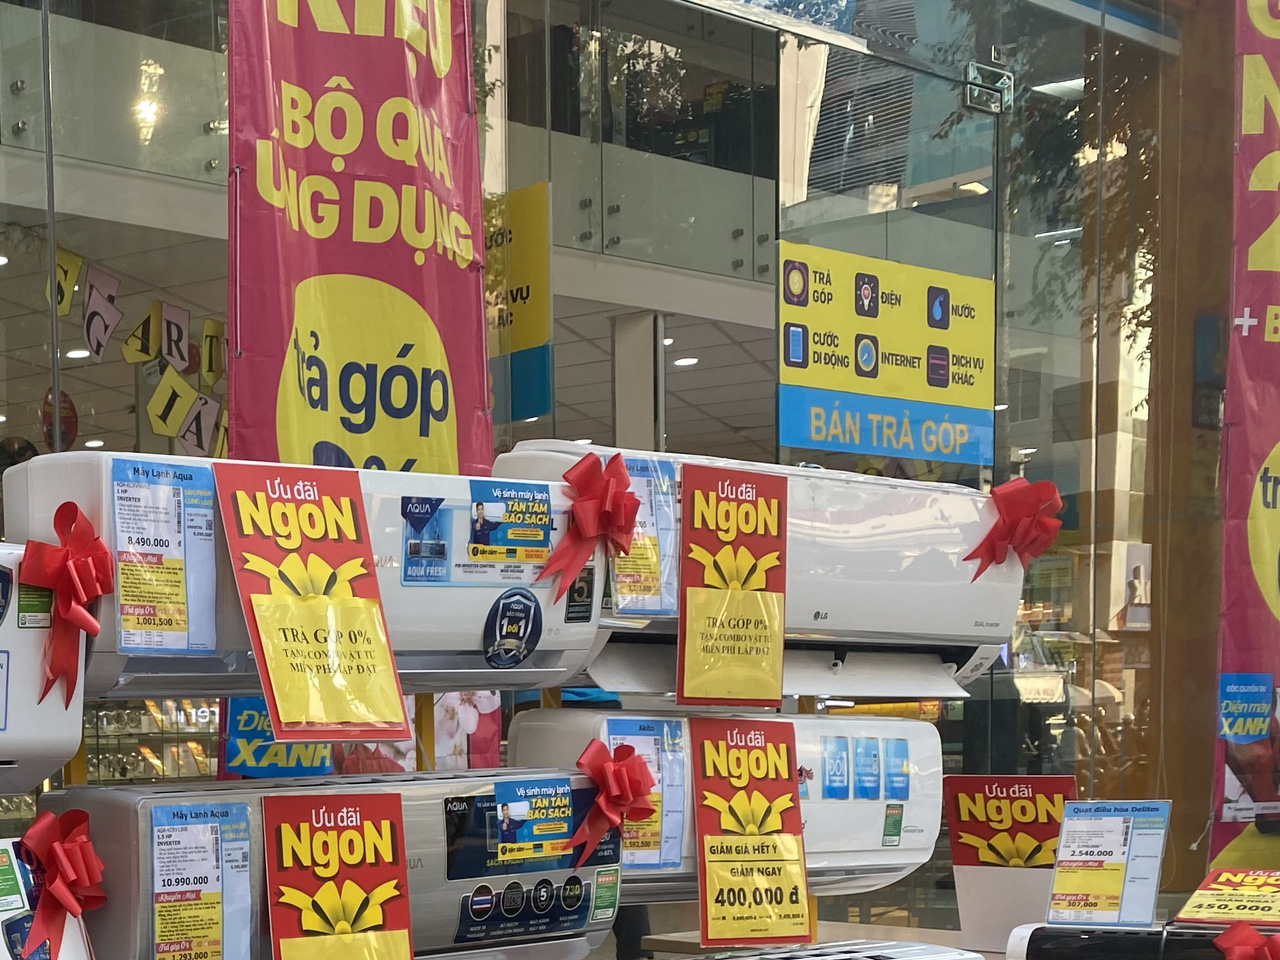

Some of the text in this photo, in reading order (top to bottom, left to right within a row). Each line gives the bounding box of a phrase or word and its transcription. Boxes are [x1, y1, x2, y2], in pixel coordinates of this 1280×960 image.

[281, 76, 451, 188] BỘ QUÀ
[353, 180, 473, 269] DỤNG
[813, 269, 831, 286] TRẢ
[813, 287, 833, 305] GÓP
[881, 290, 901, 308] ĐIỆN
[951, 303, 975, 319] NƯỚC
[813, 332, 839, 348] CƯỚC
[813, 351, 849, 369] DI ĐỘNG
[881, 352, 922, 369] INTERNET
[952, 353, 984, 373] DỊCH VỤ
[952, 371, 974, 386] KHÁC
[339, 344, 449, 437] góp
[810, 401, 968, 454] BÁN TRẢ GÓP
[127, 536, 169, 548] 8.490.000
[136, 618, 172, 627] 1,001,500
[1219, 717, 1271, 735] XANH
[228, 739, 331, 767] XANH
[161, 876, 208, 888] 10.990.000
[715, 888, 784, 909] 400,000
